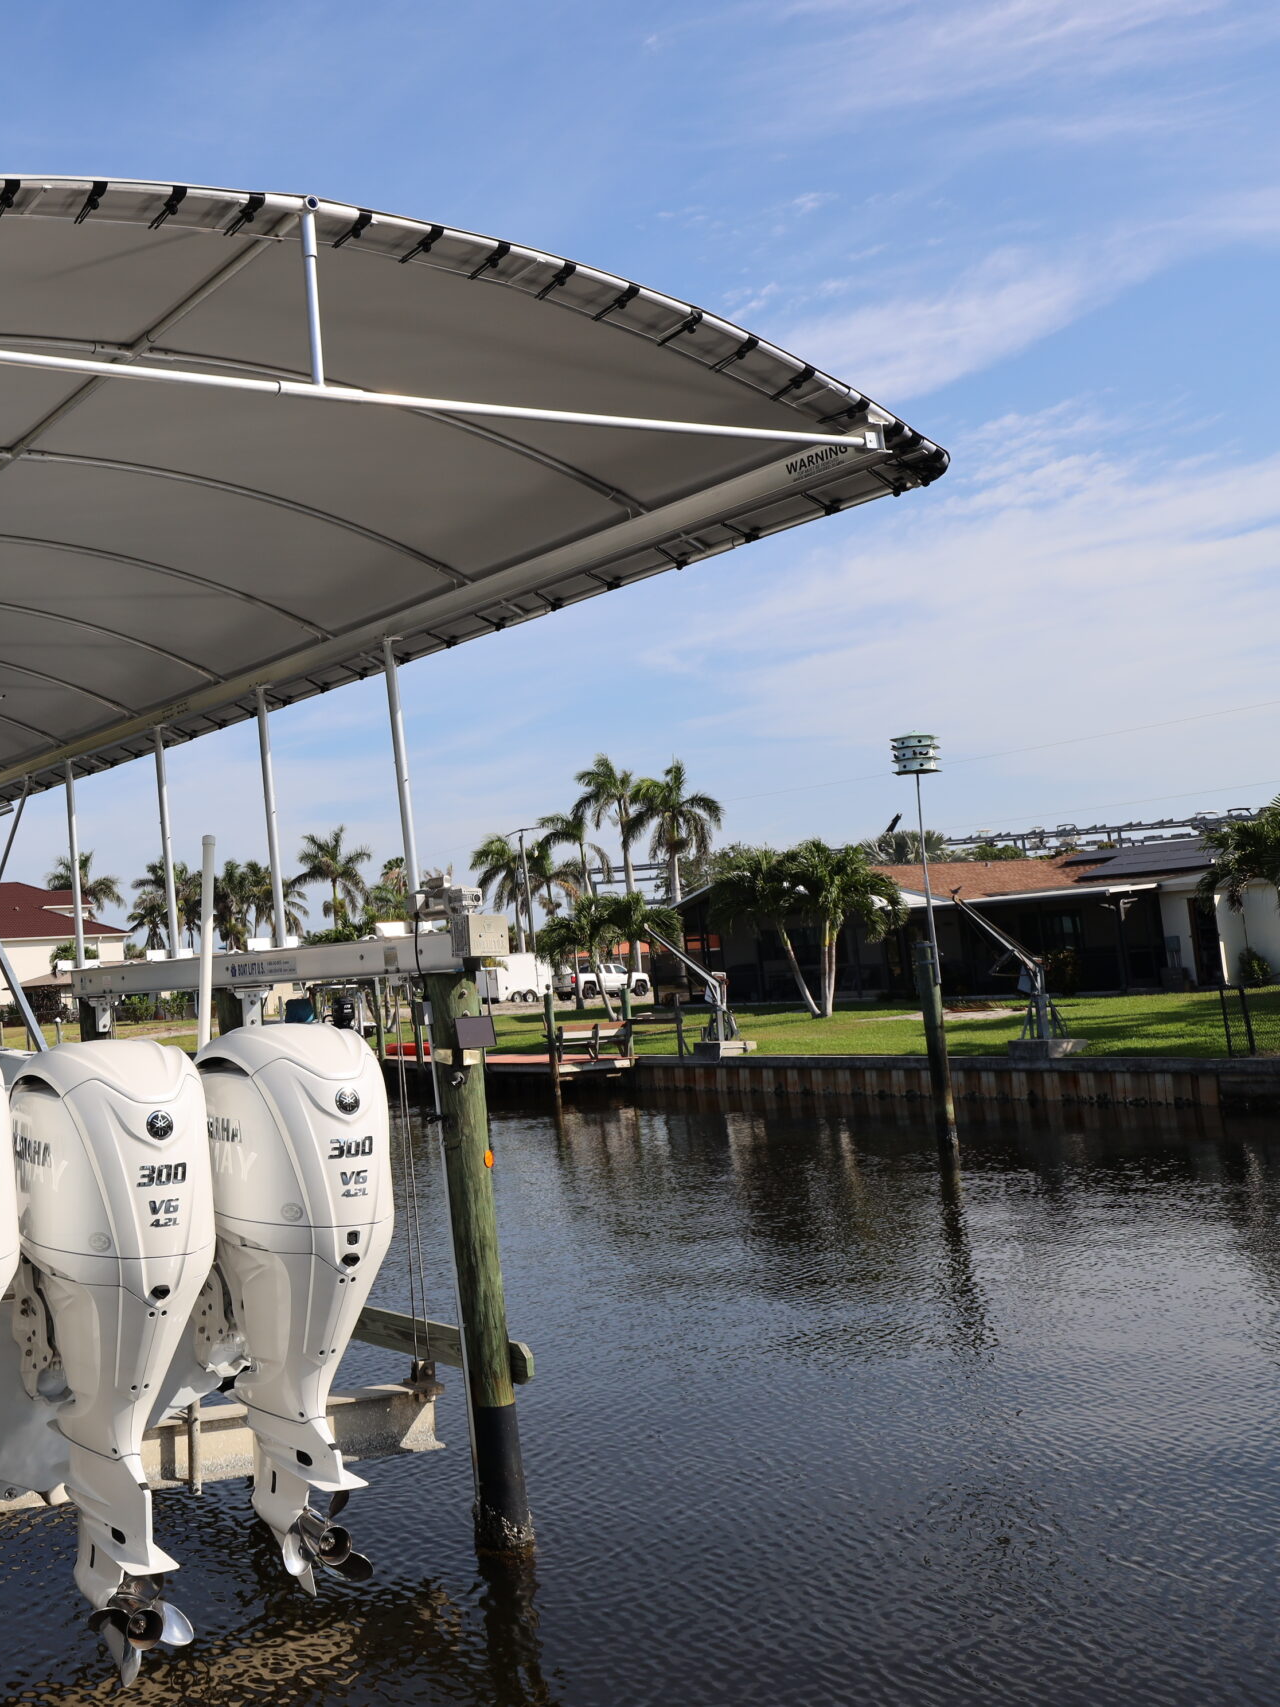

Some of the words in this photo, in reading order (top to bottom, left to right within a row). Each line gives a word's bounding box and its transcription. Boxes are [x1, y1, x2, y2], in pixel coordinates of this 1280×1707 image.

[786, 446, 848, 475] WARNING
[327, 1135, 373, 1160] 300
[136, 1162, 187, 1188] 300
[339, 1169, 368, 1186] V6
[341, 1187, 368, 1198] 4.2L
[148, 1198, 180, 1215] V6
[149, 1217, 180, 1228] 4.2L
